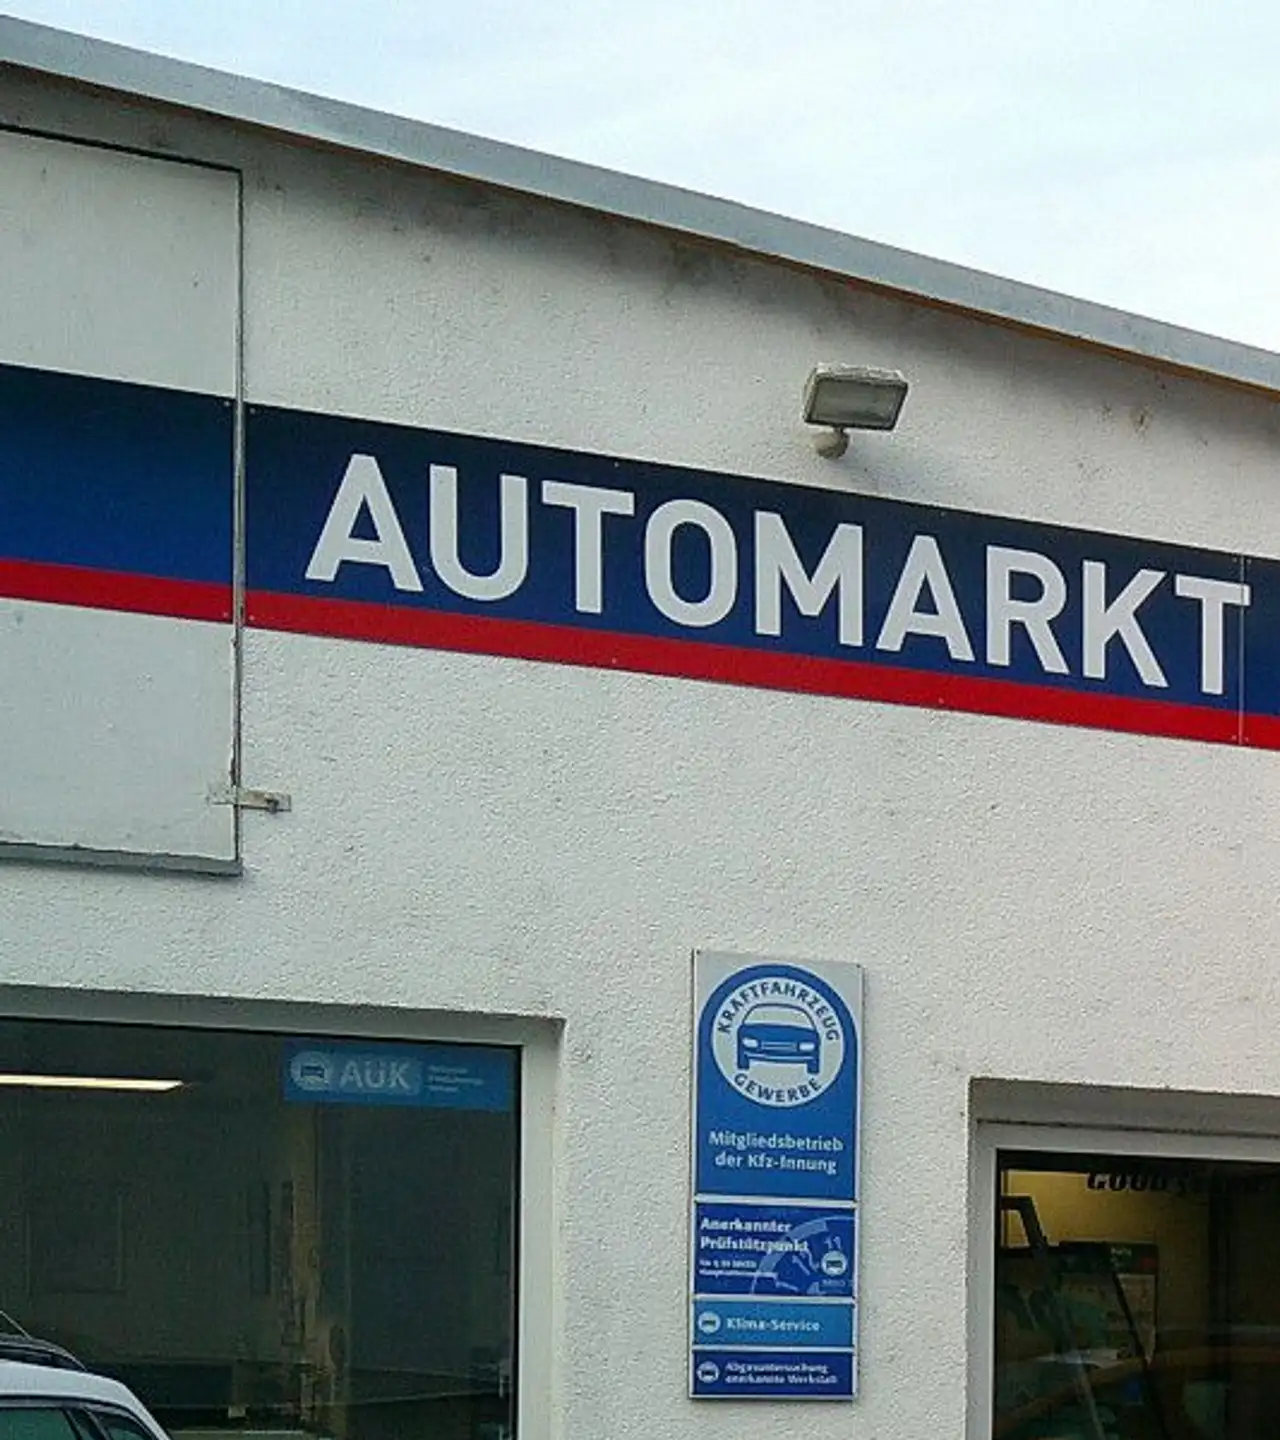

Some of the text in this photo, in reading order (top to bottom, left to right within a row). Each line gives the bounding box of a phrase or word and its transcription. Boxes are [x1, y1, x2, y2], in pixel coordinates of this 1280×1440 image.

[305, 454, 1250, 697] AUTOMARKT
[716, 980, 840, 1042] KRAFTFAHRZEUG
[734, 1072, 822, 1103] GEWERBE
[708, 1130, 844, 1151] Mitgliedsbetrieb
[715, 1152, 837, 1175] der Kfz-Innung
